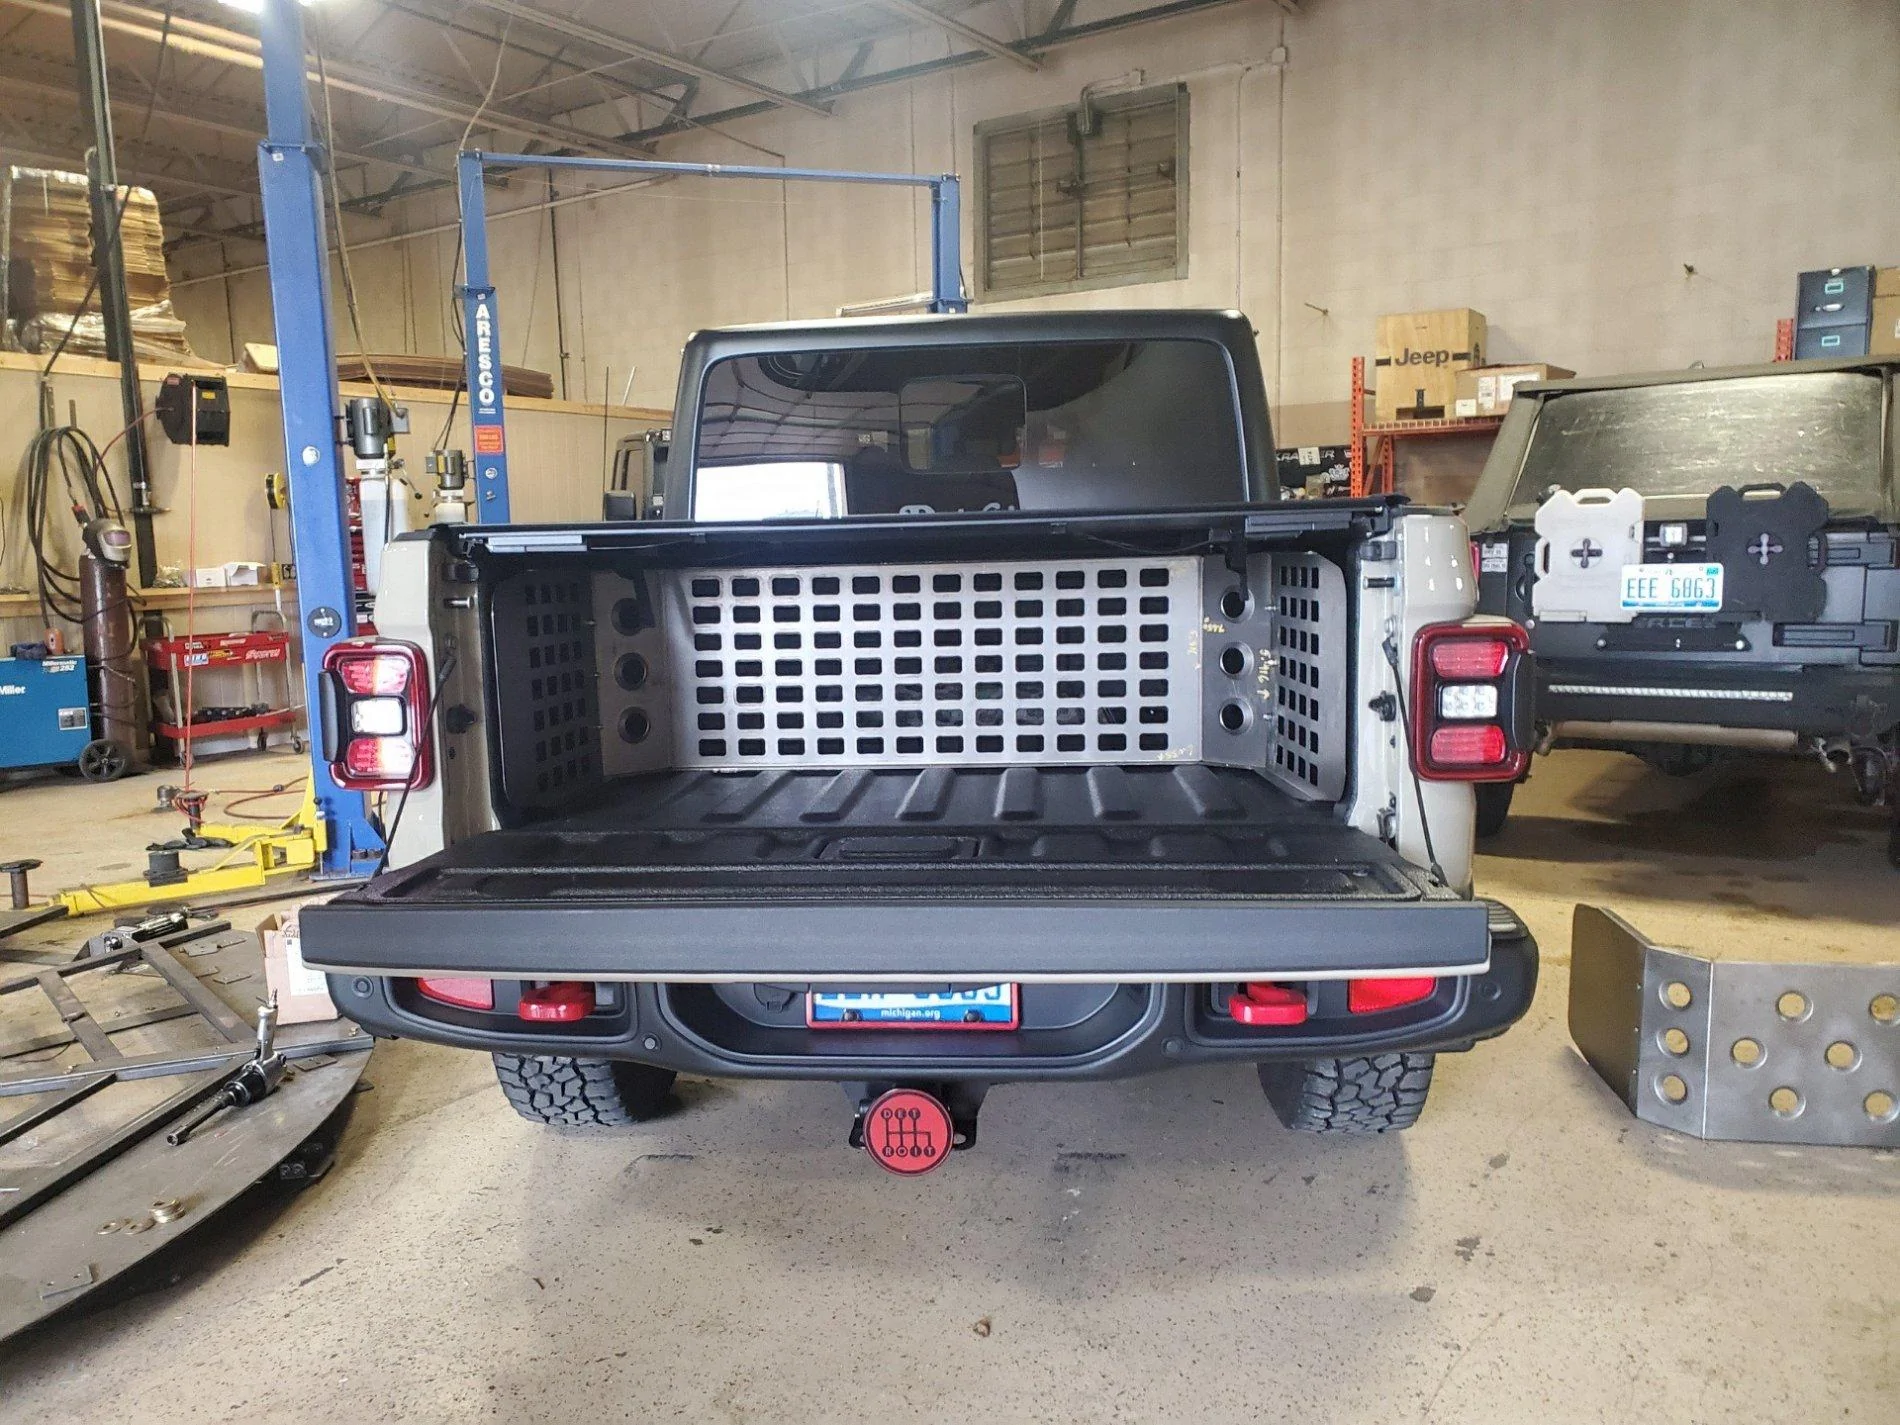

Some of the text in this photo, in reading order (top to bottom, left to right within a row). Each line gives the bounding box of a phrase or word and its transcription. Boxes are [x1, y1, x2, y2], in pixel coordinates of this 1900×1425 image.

[475, 304, 495, 405] ARESCO
[1395, 348, 1449, 367] Jeep
[1627, 577, 1715, 599] EEE 6863
[881, 1008, 941, 1020] michigan.org
